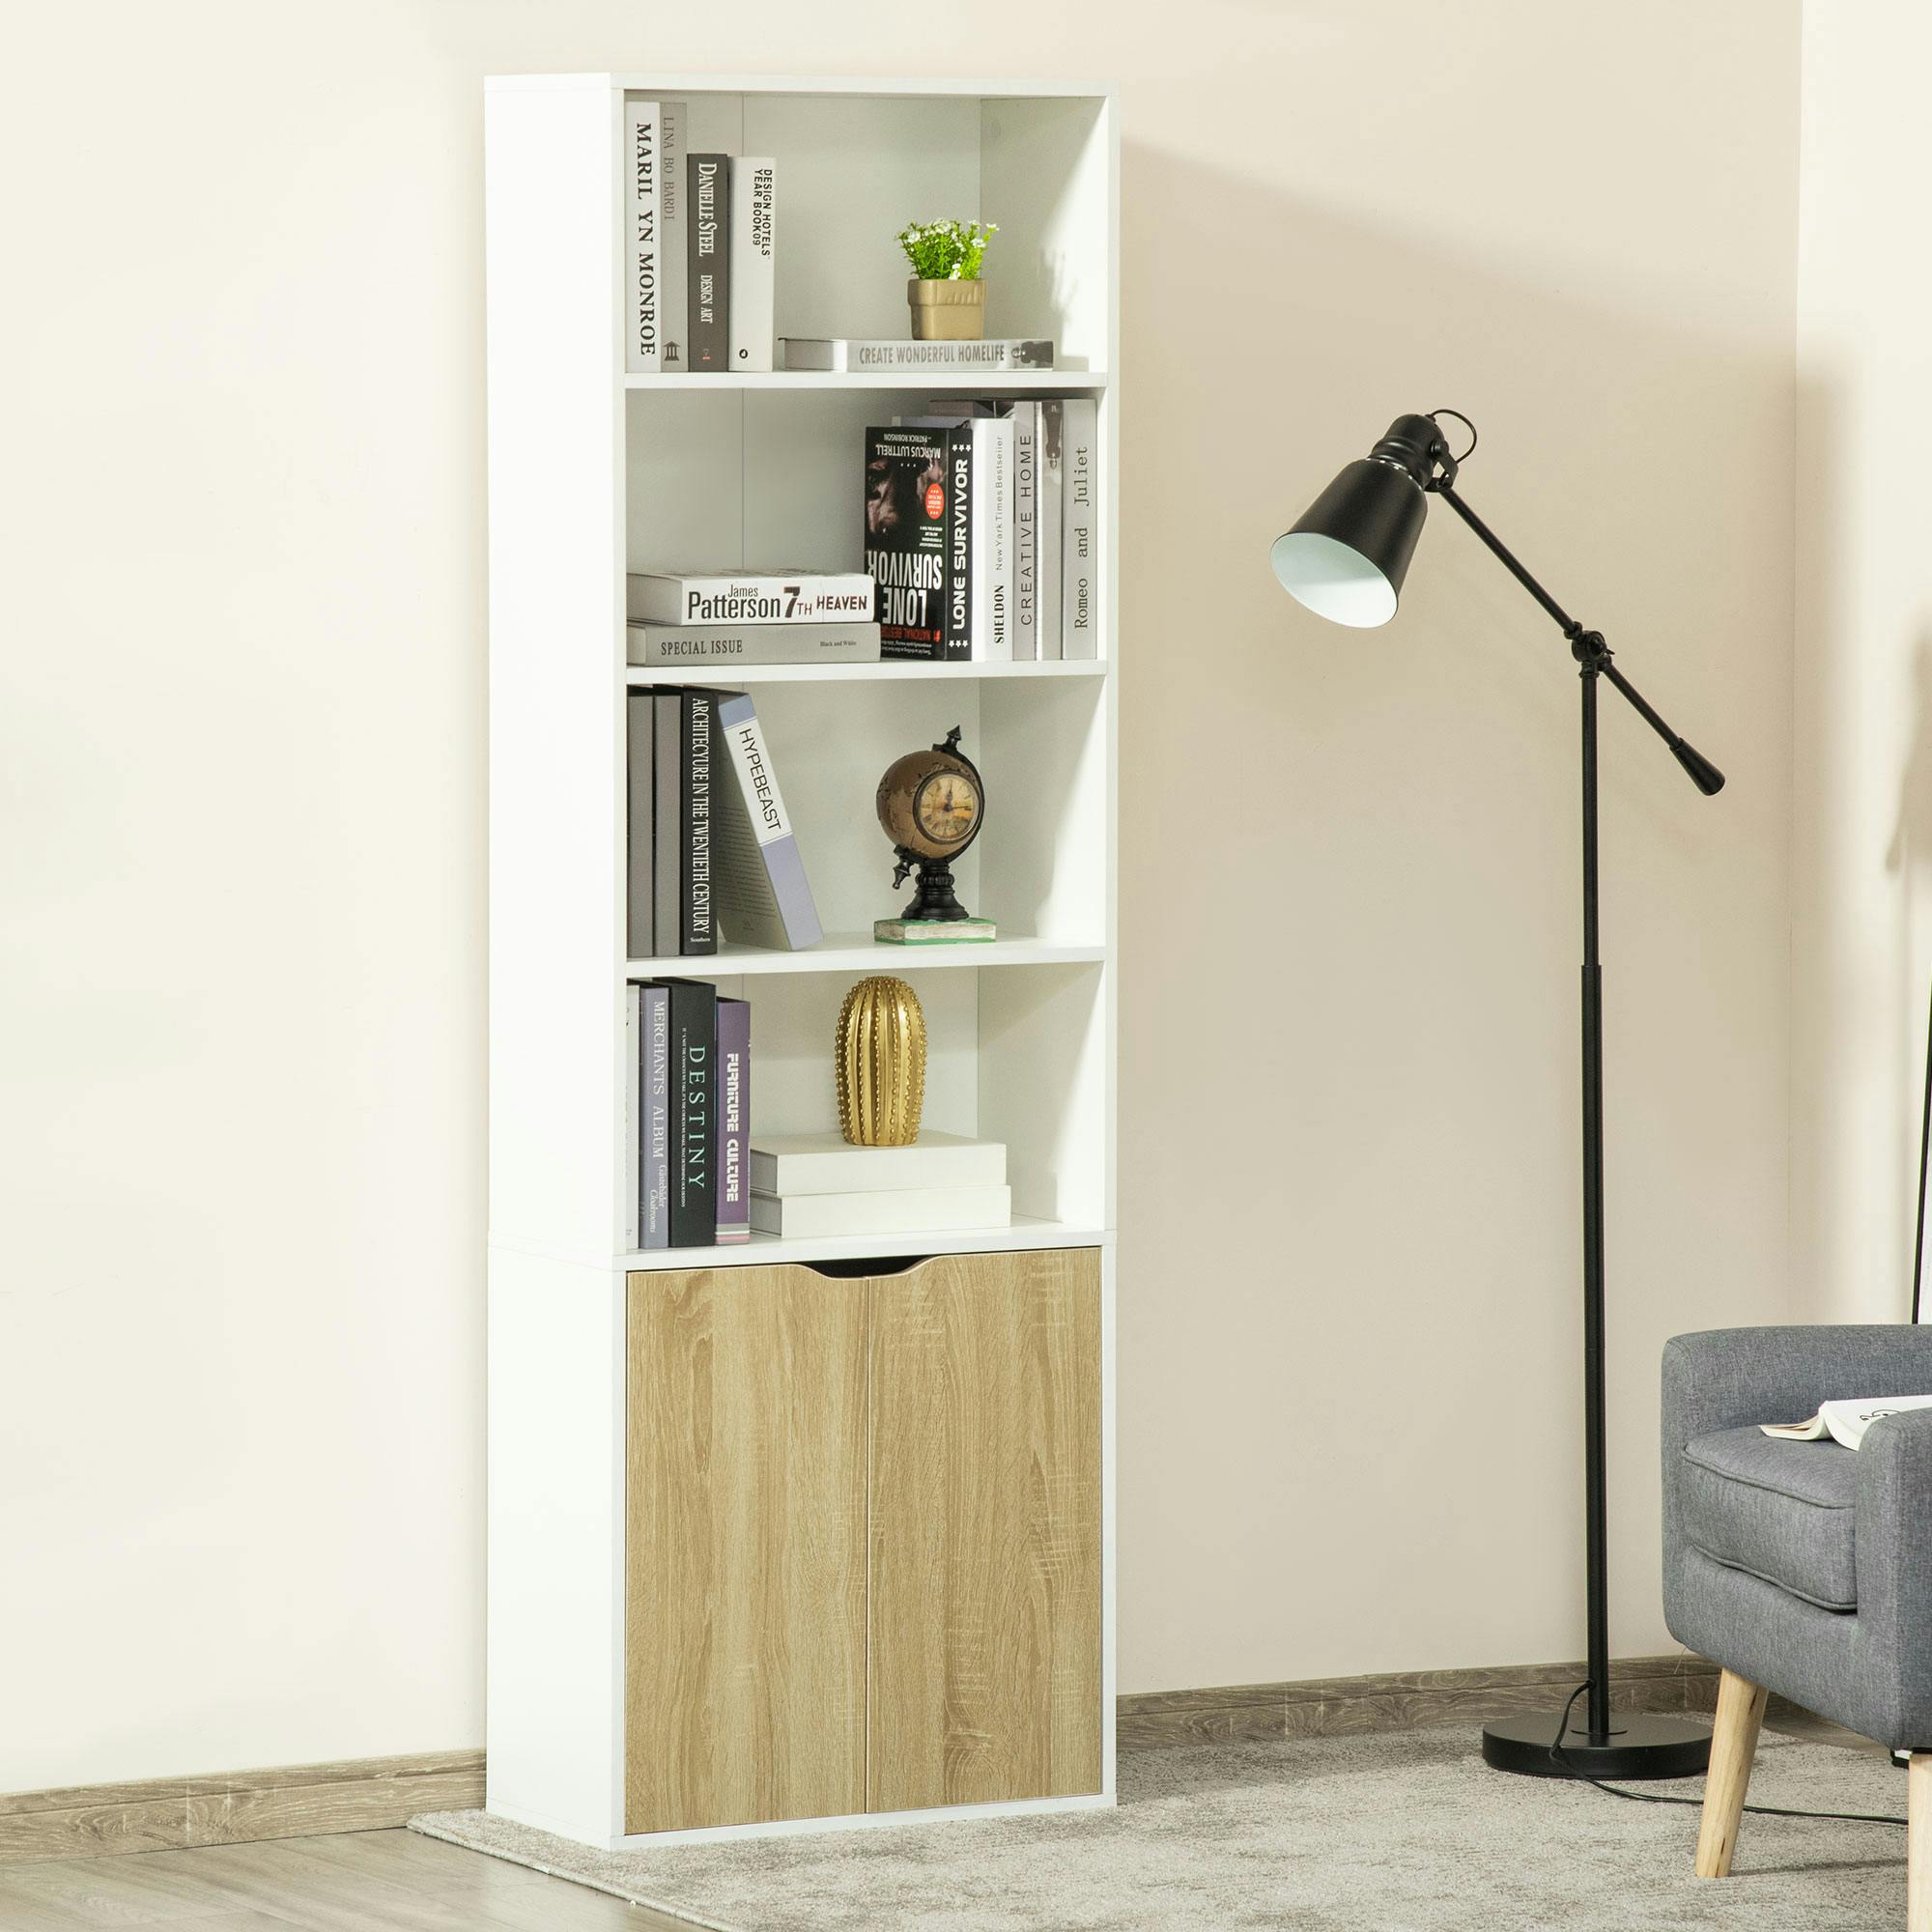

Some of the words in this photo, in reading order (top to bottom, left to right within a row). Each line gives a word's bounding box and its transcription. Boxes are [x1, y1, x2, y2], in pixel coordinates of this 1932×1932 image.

[664, 117, 674, 149] LINA
[637, 123, 652, 200] MARIL
[664, 157, 674, 174] BO
[753, 168, 763, 197] YEAR
[664, 182, 675, 220] BARDI
[698, 162, 717, 220] DANIELLE
[763, 169, 772, 210] DESIGN
[639, 210, 654, 242] YN
[698, 221, 718, 257] STEEL
[753, 202, 762, 245] BOOK09
[761, 213, 771, 256] HOTELS
[639, 252, 656, 355] MONROE
[700, 274, 713, 304] DESIGN
[700, 307, 713, 324] ART
[859, 347, 894, 365] CREATE
[896, 345, 955, 364] WONDERFUL
[957, 344, 1005, 363] HOMELIFE
[875, 443, 910, 458] LUTTRELL
[911, 444, 941, 459] MARCUS
[1019, 435, 1032, 497] HOME
[1073, 446, 1089, 506] Juliet
[953, 459, 968, 571] SURVIVOR
[1074, 526, 1089, 558] and
[867, 550, 943, 590] SURVIVOR
[1020, 512, 1032, 626] CREATIVE
[688, 591, 781, 620] Patterson
[816, 595, 867, 611] HEAVEN
[727, 584, 758, 598] James
[882, 586, 927, 628] LONE
[952, 577, 966, 630] LONE
[1074, 578, 1089, 629] Romeo
[994, 584, 1005, 644] SHELDON
[661, 639, 707, 656] SPECIAL
[711, 639, 743, 654] ISSUE
[692, 782, 709, 795] IN
[739, 728, 781, 830] HYPEBEAST
[692, 796, 709, 818] THE
[693, 819, 709, 881] TWENTIETH
[693, 883, 710, 933] CENTURY
[653, 1001, 666, 1094] MERCHANTS
[726, 1053, 739, 1132] FURNITURE
[652, 1106, 665, 1158] ALBUM
[688, 1045, 706, 1189] DESTINY
[726, 1139, 739, 1203] CULTURE
